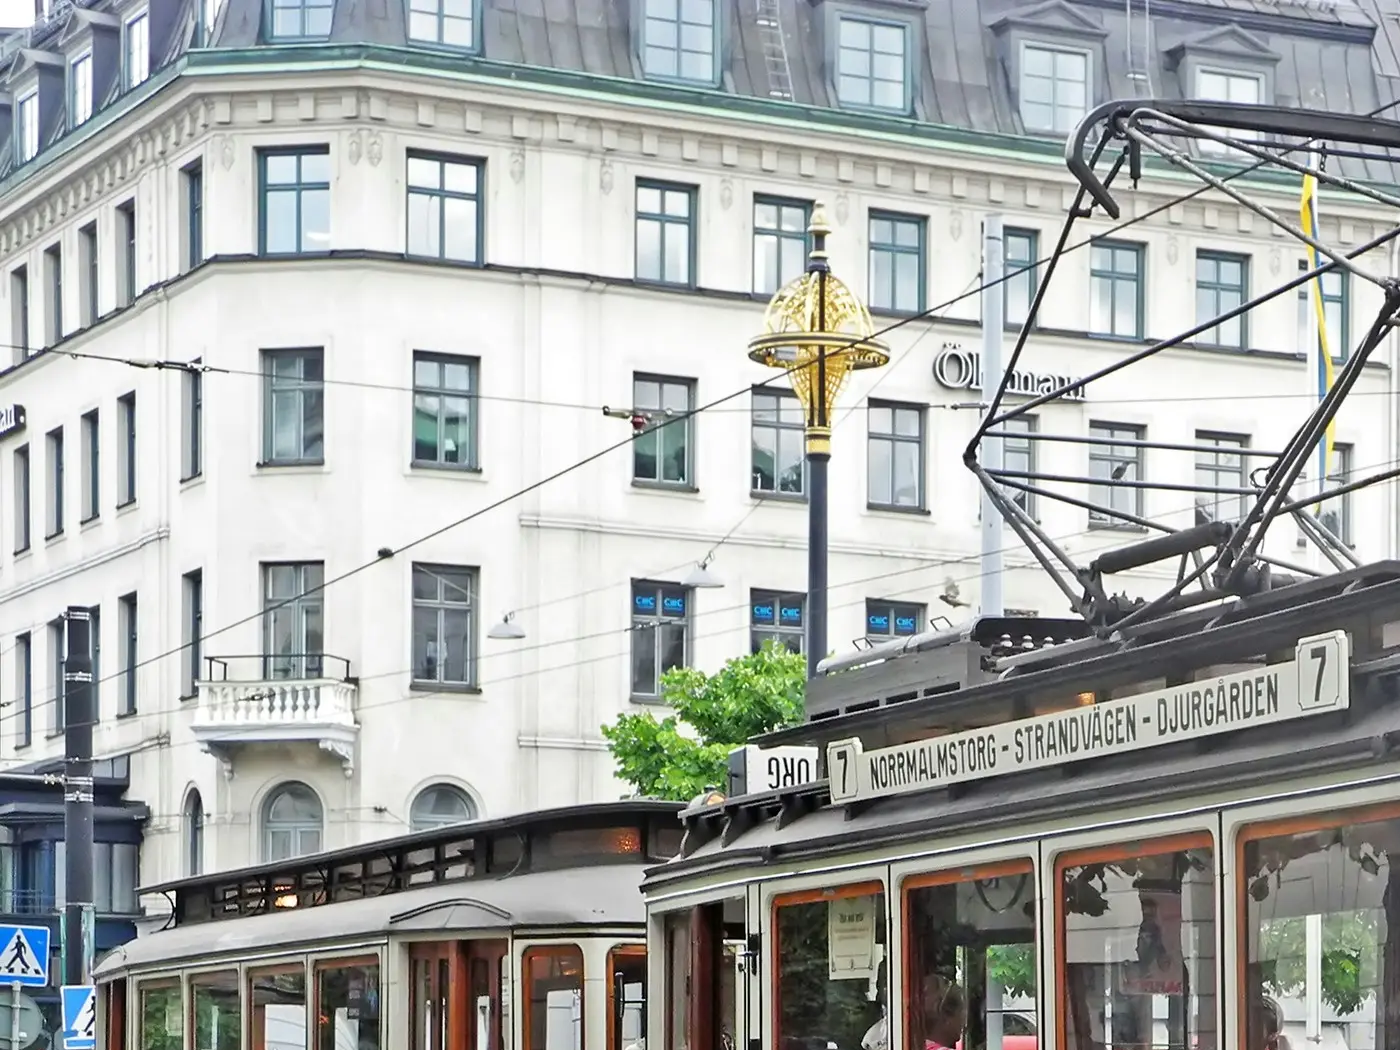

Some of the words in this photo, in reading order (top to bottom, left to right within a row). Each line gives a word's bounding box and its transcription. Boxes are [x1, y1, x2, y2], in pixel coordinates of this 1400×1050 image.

[1310, 646, 1327, 702] 7
[836, 749, 848, 794] 7
[869, 733, 996, 790] NORRMALMSTORG
[1014, 704, 1136, 763] STRANDVÄGEN
[1157, 672, 1279, 737] DJURGÅRDEN
